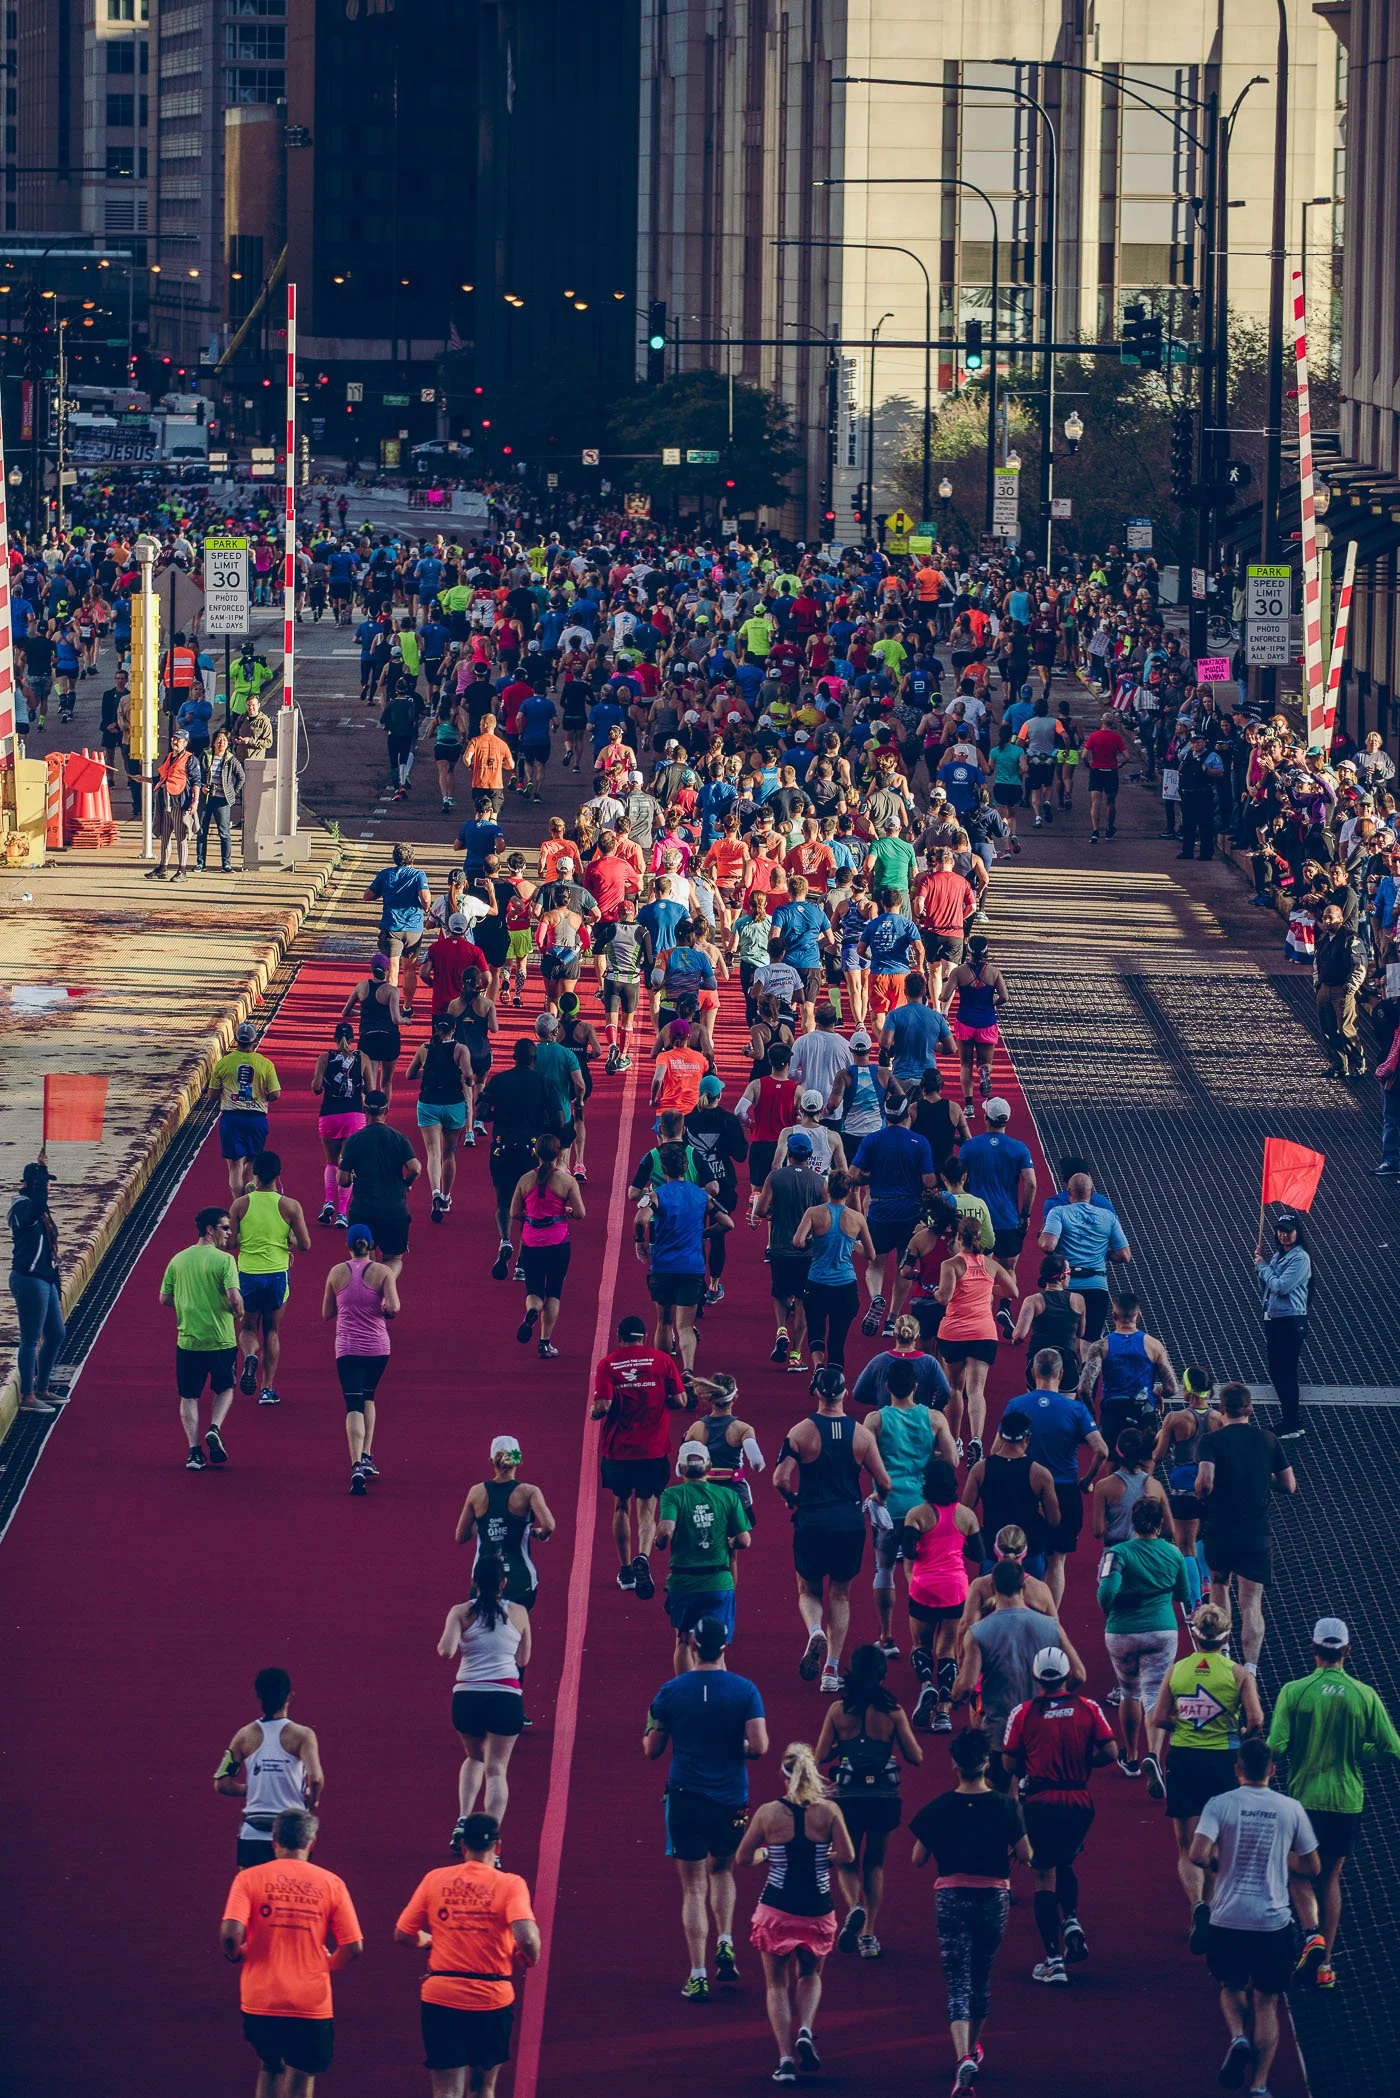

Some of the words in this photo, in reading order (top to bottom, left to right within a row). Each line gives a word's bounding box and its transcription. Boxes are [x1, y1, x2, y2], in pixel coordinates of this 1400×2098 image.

[104, 443, 154, 461] JESUS
[998, 486, 1014, 496] 30
[213, 540, 238, 549] PARK
[1256, 568, 1282, 576] PARK
[213, 572, 240, 588] 30
[1253, 580, 1285, 588] SPEED
[1254, 599, 1283, 616] 30
[692, 1512, 715, 1523] ONE
[487, 1526, 508, 1537] ONE
[1180, 1704, 1215, 1716] MATT
[294, 1895, 319, 1905] TEAM
